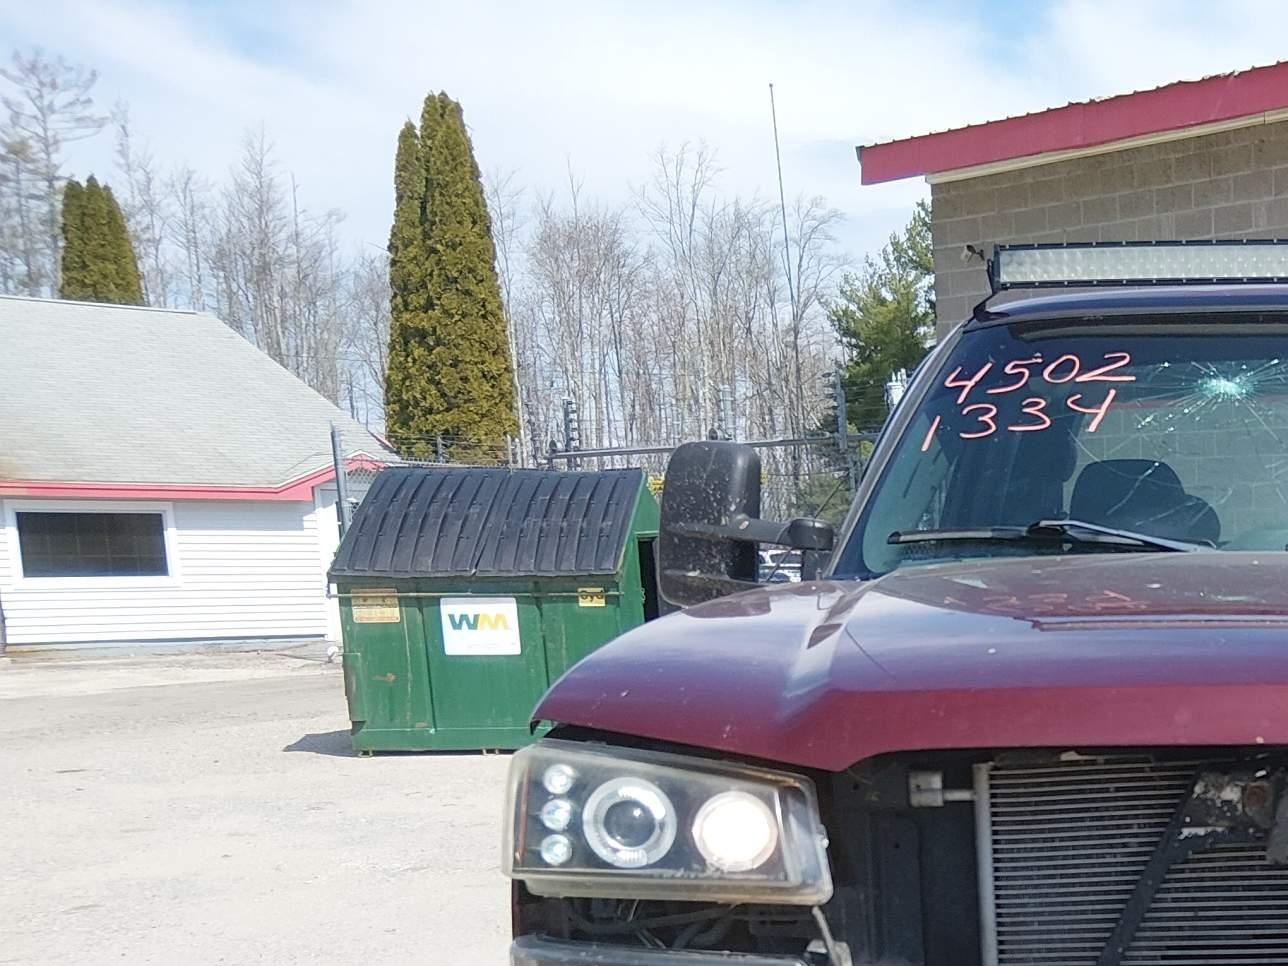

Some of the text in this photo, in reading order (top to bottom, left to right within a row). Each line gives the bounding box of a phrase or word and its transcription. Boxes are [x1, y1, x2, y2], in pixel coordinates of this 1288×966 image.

[944, 352, 1137, 404] 4502
[921, 388, 1117, 452] 1334
[447, 613, 510, 631] WM
